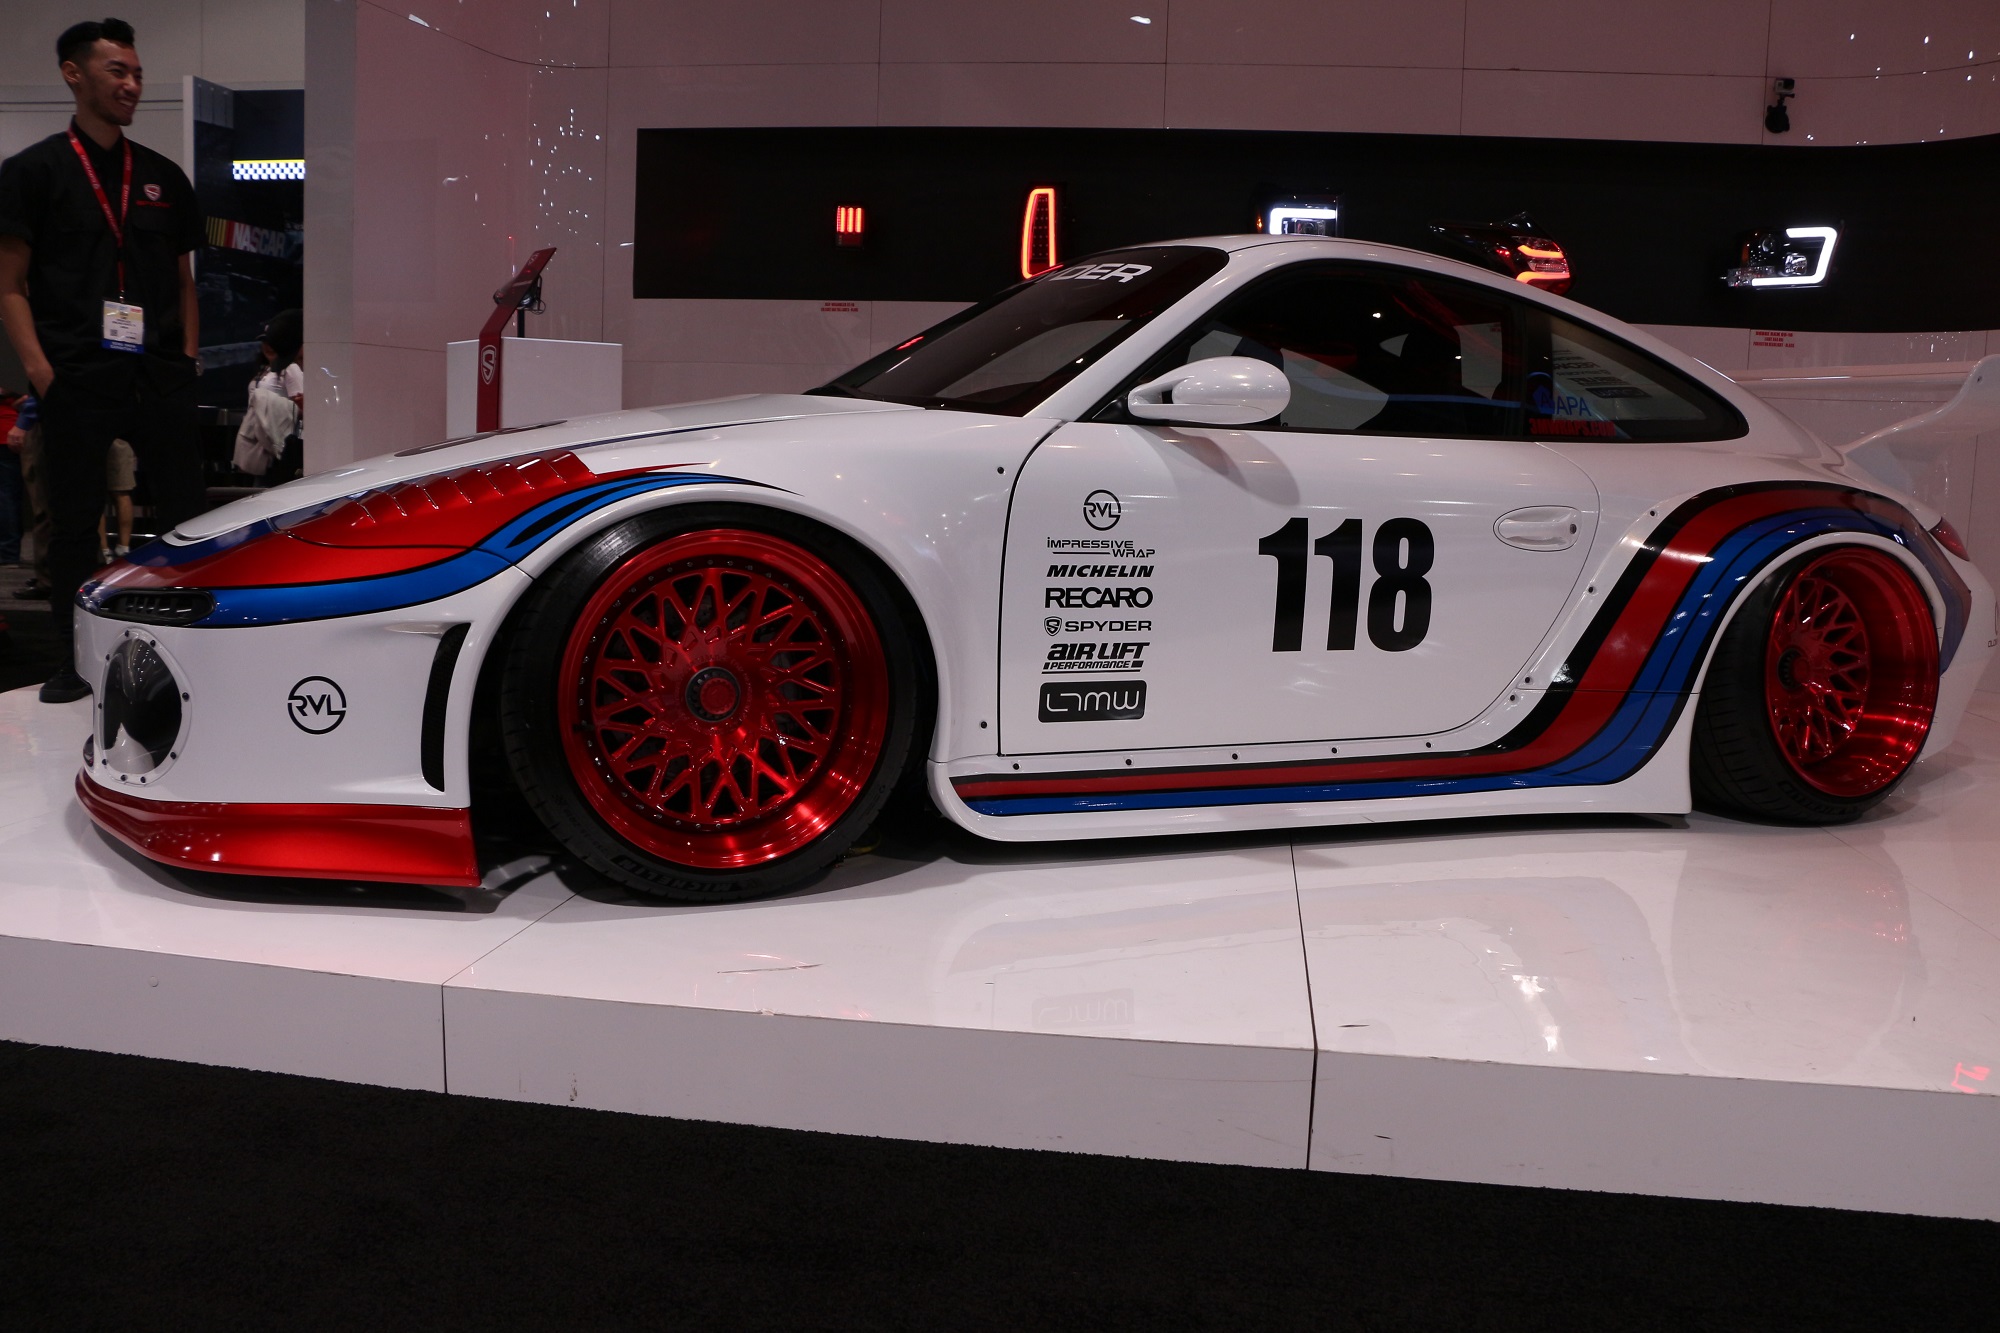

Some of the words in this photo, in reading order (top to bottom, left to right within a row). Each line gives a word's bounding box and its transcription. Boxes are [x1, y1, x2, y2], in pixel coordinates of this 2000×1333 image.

[231, 221, 287, 259] NASCAR
[1556, 396, 1592, 417] APA
[1111, 549, 1156, 558] WRAP
[1046, 564, 1155, 578] MICHELIN
[1258, 517, 1435, 653] 118
[1044, 586, 1154, 609] RECARO
[1064, 620, 1152, 632] SPYDER
[620, 857, 733, 891] MICHELIN
